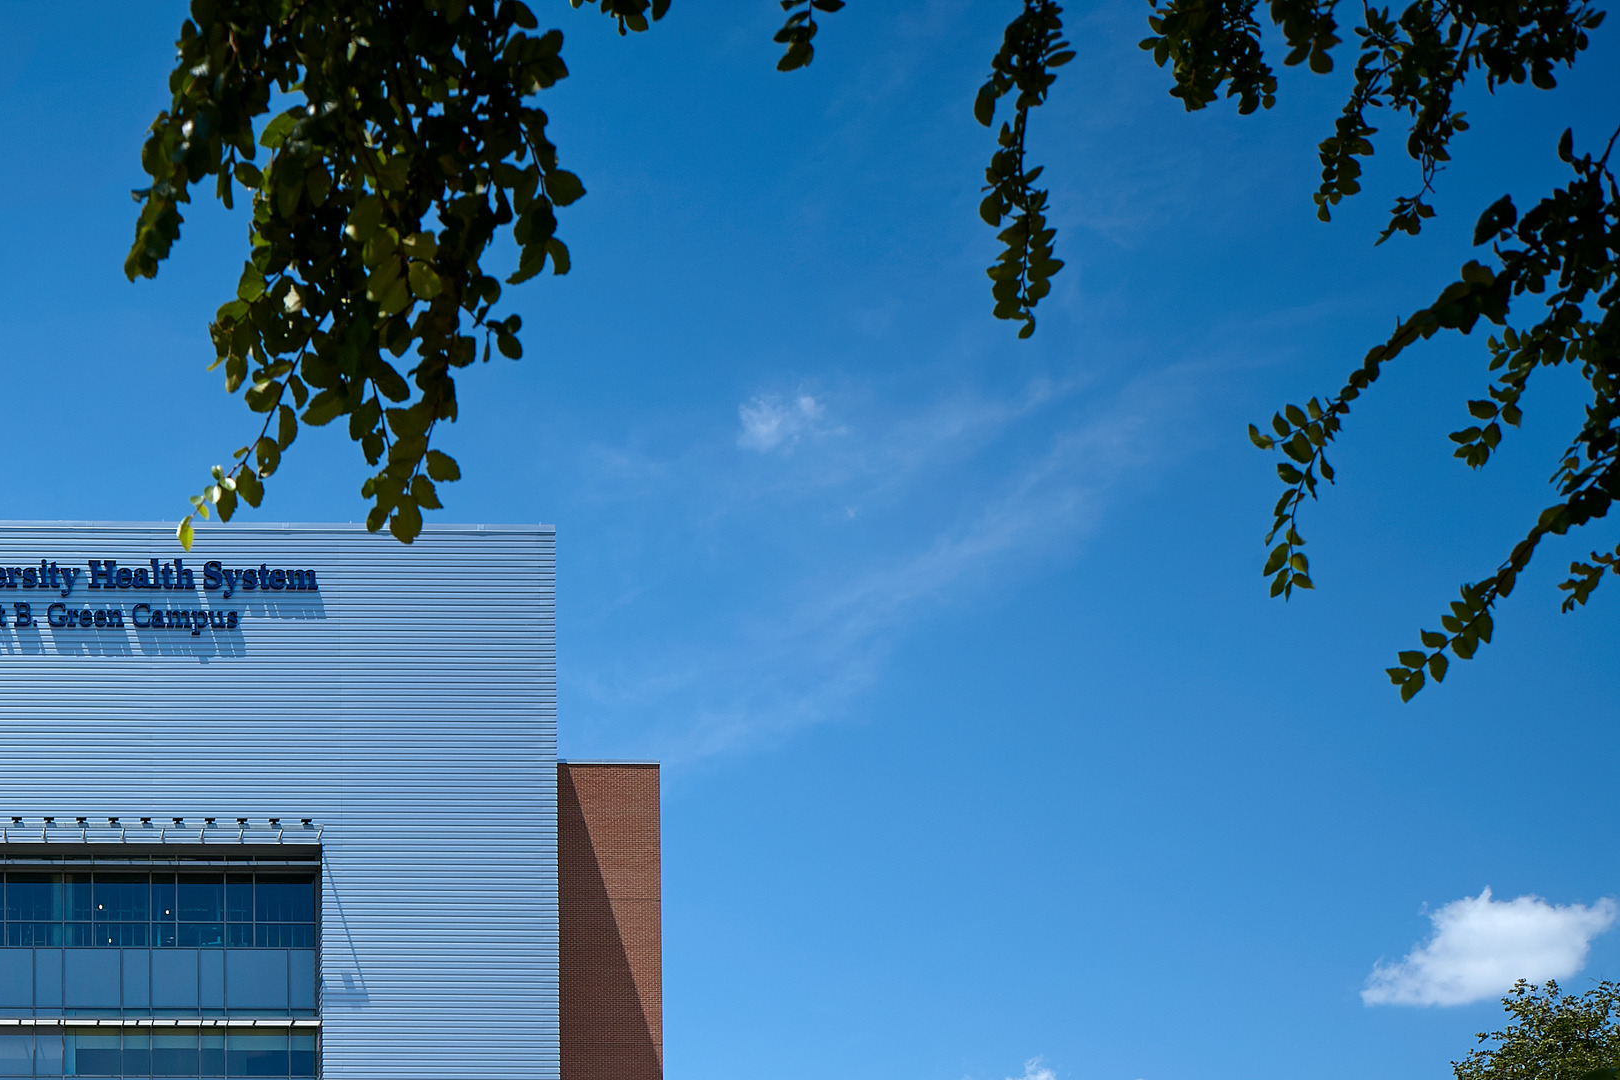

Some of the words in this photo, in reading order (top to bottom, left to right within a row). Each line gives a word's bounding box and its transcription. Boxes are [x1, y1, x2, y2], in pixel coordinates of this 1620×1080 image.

[88, 558, 195, 589] Health
[203, 560, 318, 598] System
[14, 602, 38, 627] B.
[48, 602, 124, 627] Green
[132, 602, 238, 636] Campus
